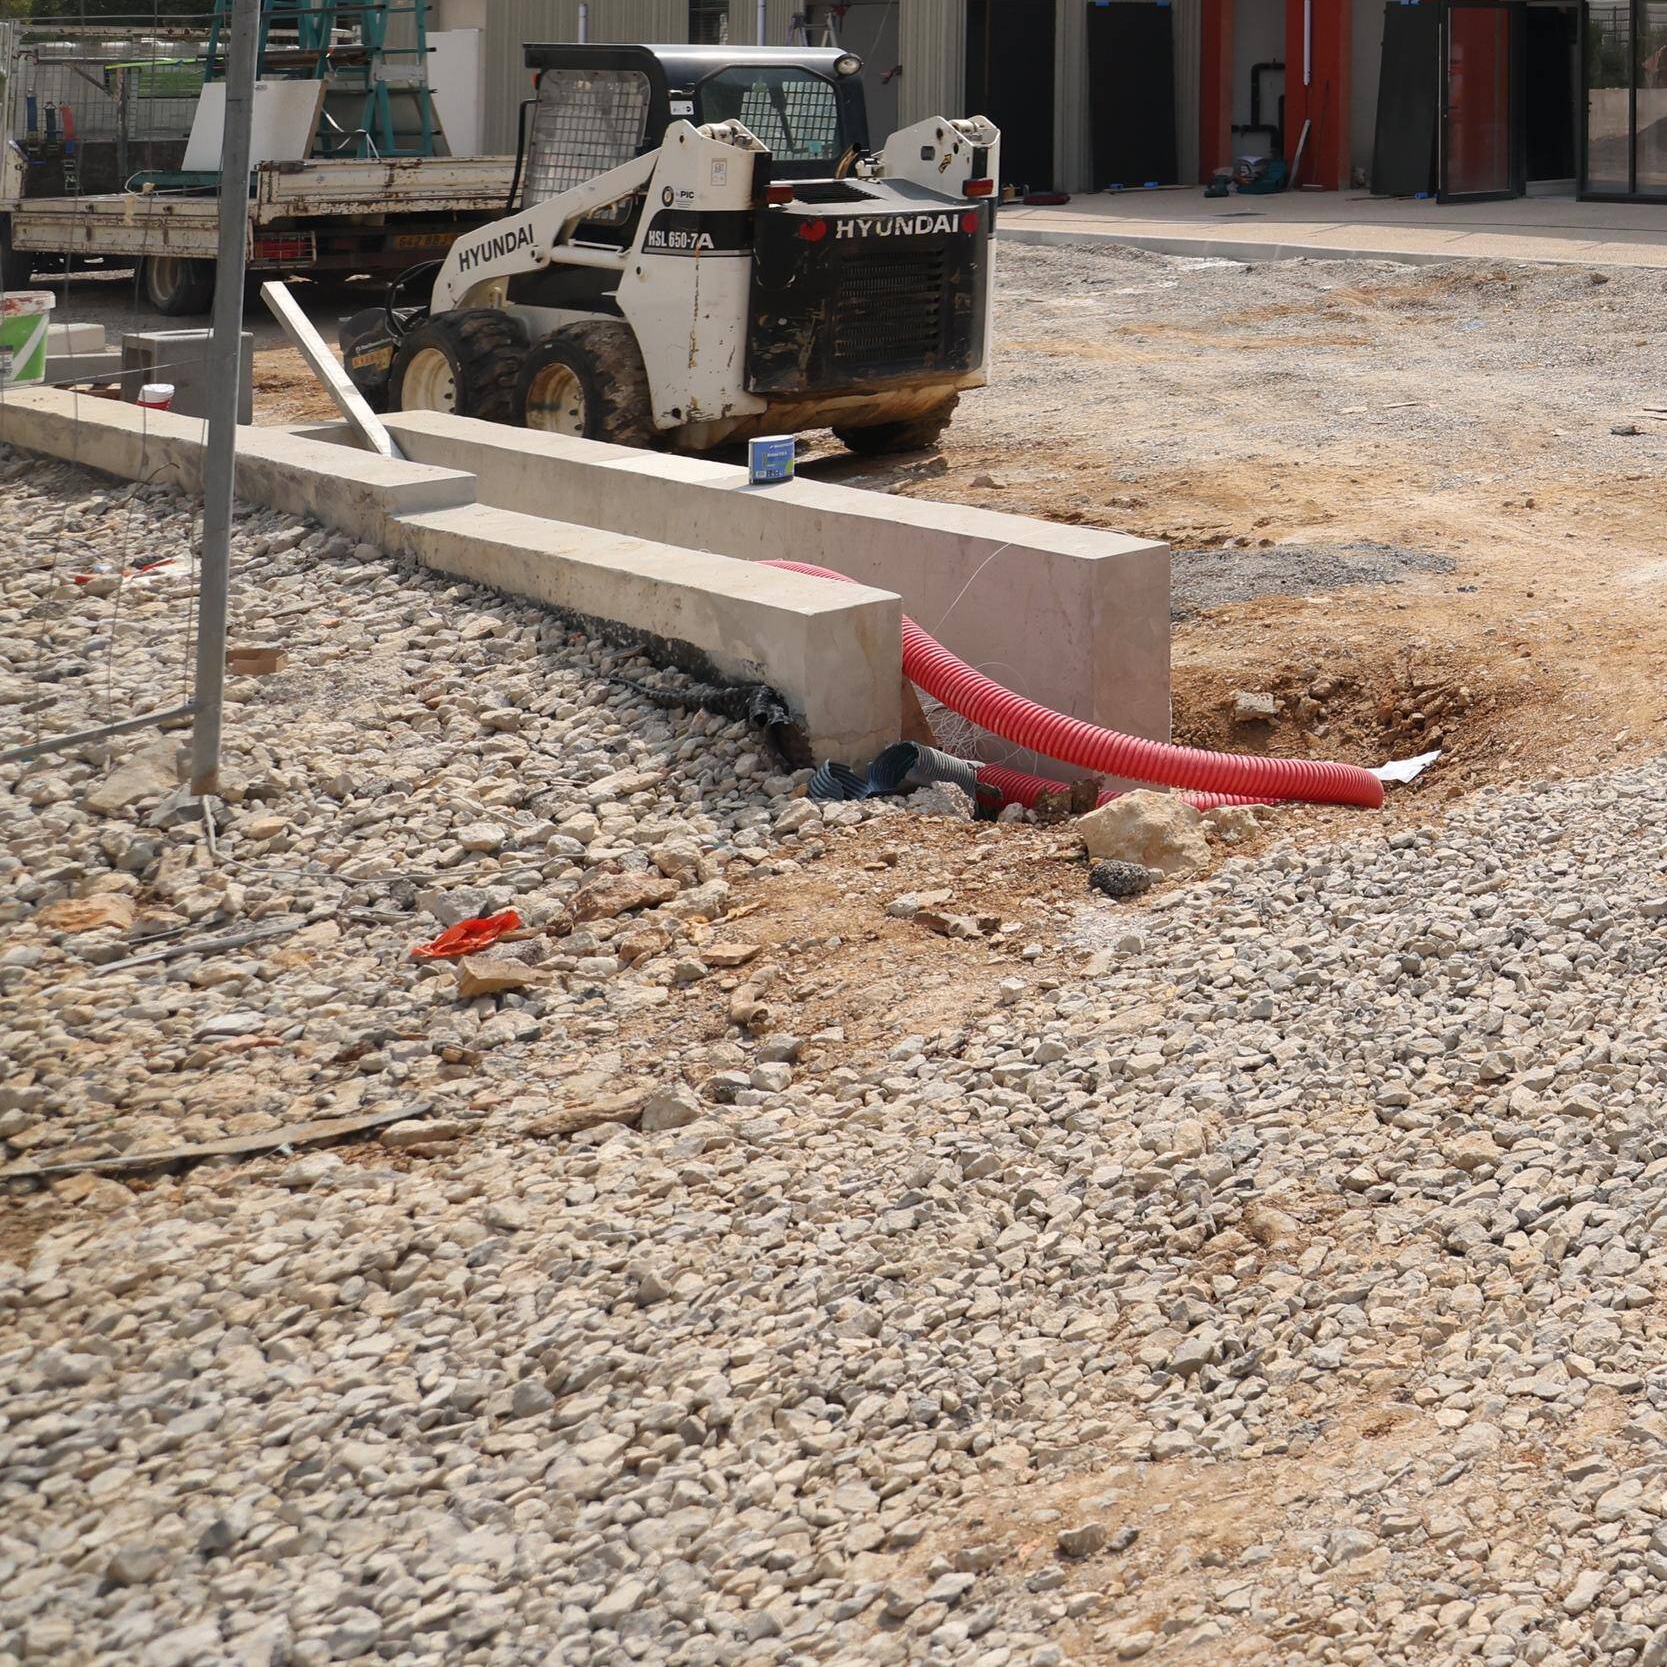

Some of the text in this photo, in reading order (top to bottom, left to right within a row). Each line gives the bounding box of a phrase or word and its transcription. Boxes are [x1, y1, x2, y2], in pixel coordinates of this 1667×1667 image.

[648, 230, 668, 247] HSL
[835, 214, 958, 239] HYUNDAI
[458, 223, 534, 273] HYUNDAI
